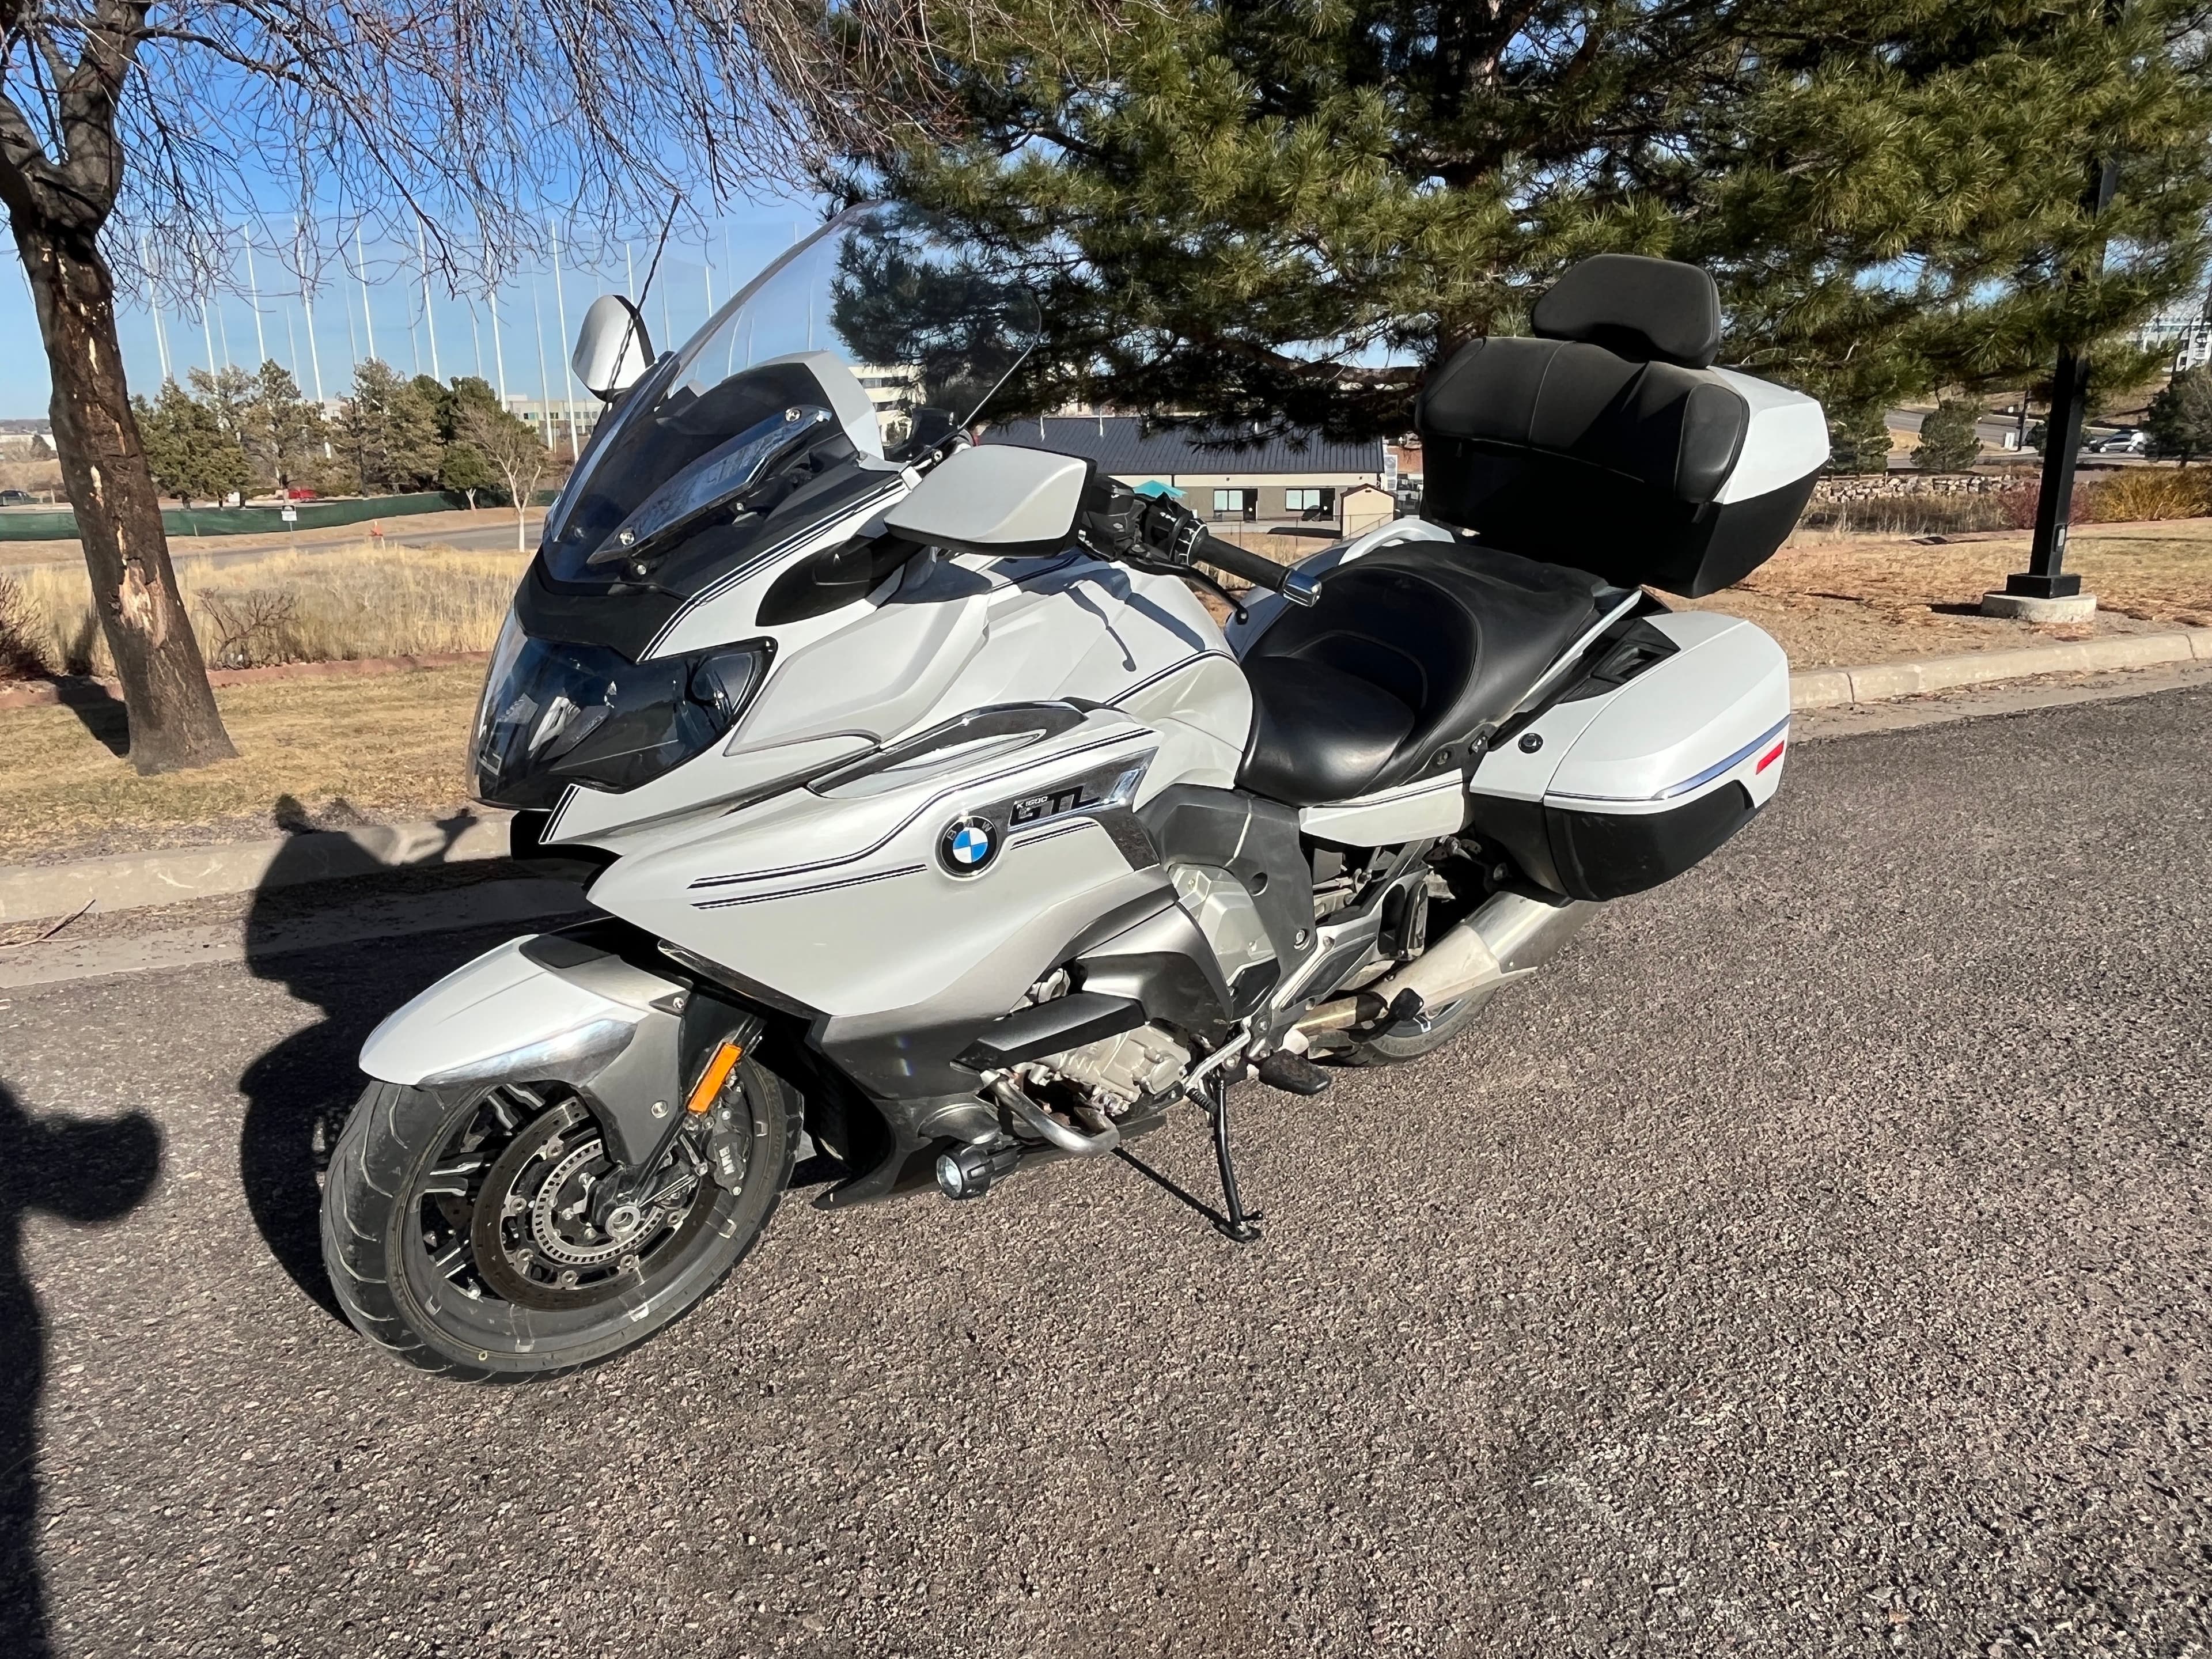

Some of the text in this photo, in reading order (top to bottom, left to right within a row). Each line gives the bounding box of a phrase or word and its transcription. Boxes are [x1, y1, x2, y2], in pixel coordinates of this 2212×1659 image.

[1009, 785, 1101, 827] GTL
[1025, 796, 1048, 806] 1600
[946, 818, 993, 841] BMW
